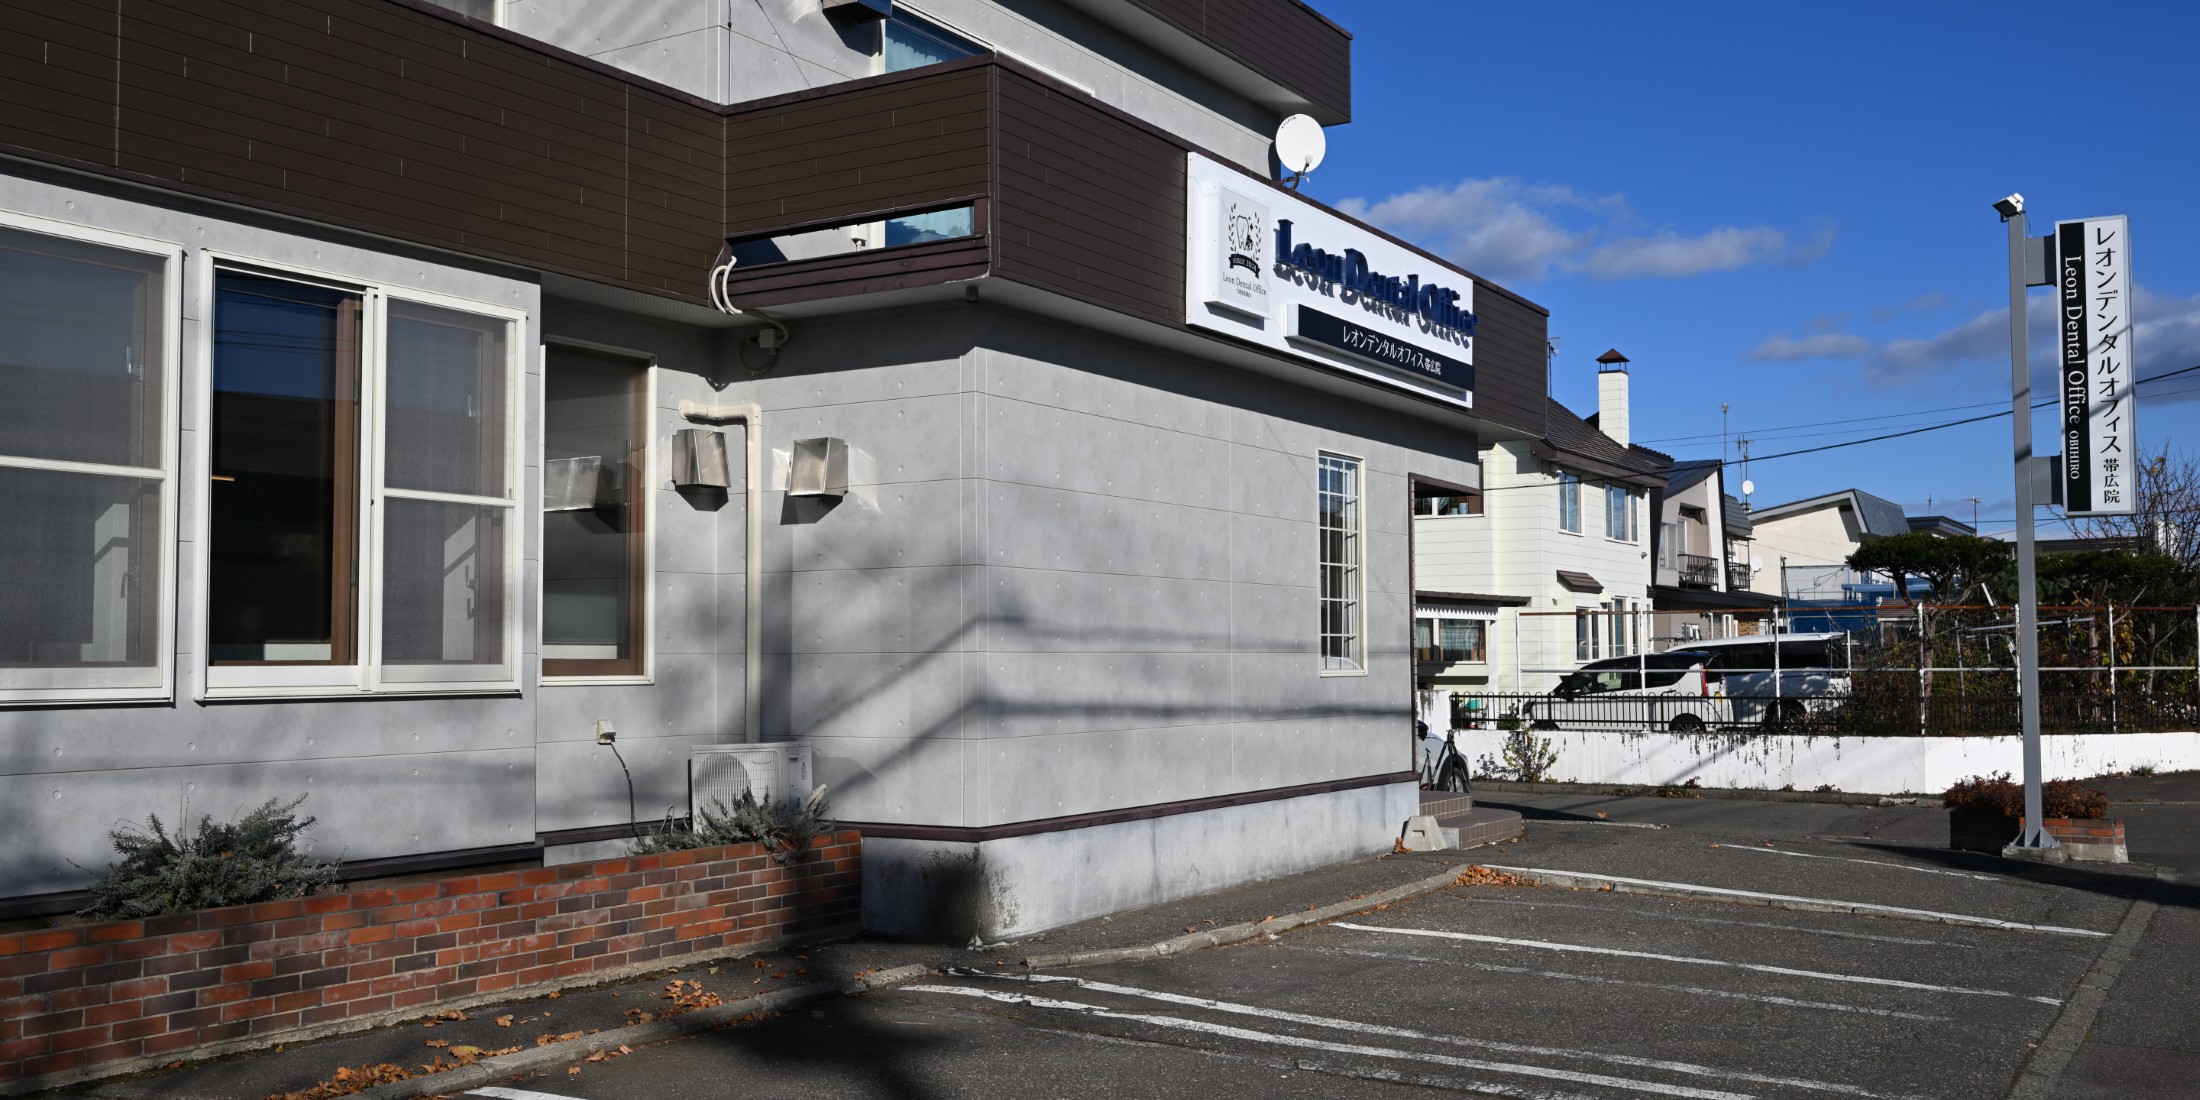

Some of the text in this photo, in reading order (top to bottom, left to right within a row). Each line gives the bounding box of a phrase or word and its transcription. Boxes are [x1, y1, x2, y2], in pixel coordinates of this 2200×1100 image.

[1223, 272, 1267, 295] Leon Dental Office
[1233, 255, 1245, 265] since
[1276, 219, 1479, 337] Leon Dental Office
[2065, 255, 2085, 480] Leon Dental Office OBIHIRO
